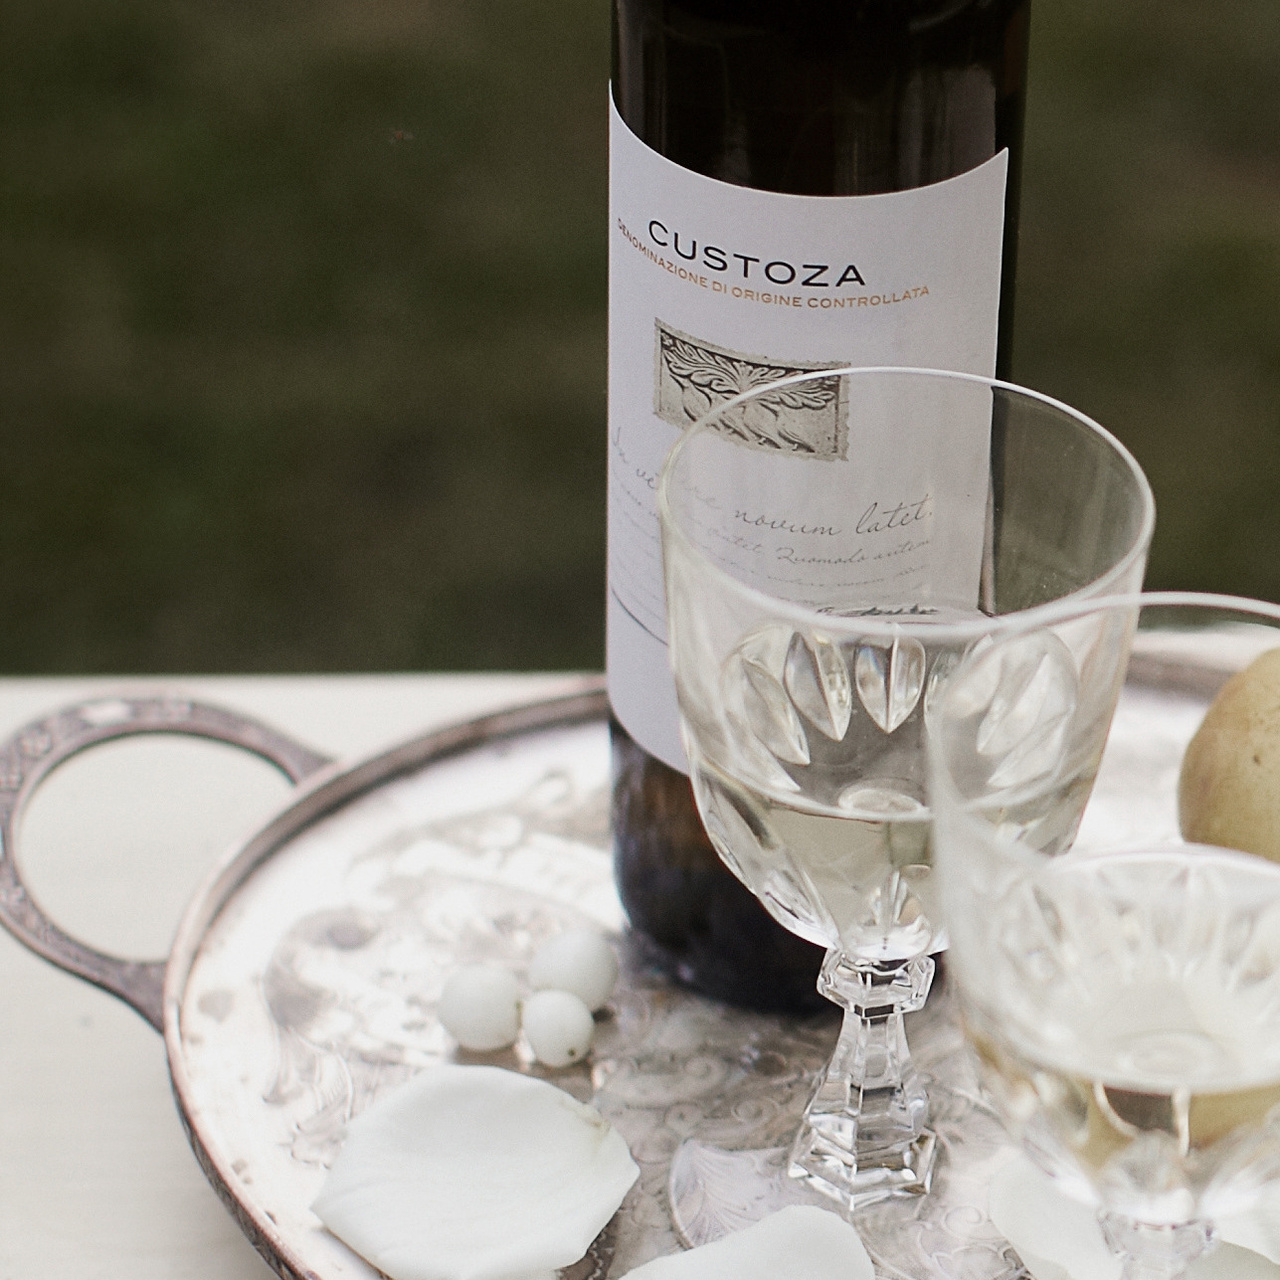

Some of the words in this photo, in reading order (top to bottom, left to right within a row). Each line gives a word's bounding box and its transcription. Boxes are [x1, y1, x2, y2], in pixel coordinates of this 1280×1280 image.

[617, 217, 709, 288] DENOMINAZIONE
[711, 280, 728, 294] DI
[731, 286, 803, 308] ORIGINE
[806, 285, 930, 309] CONTROLLATA
[648, 220, 866, 287] CUSTOZA
[734, 508, 842, 536] novum
